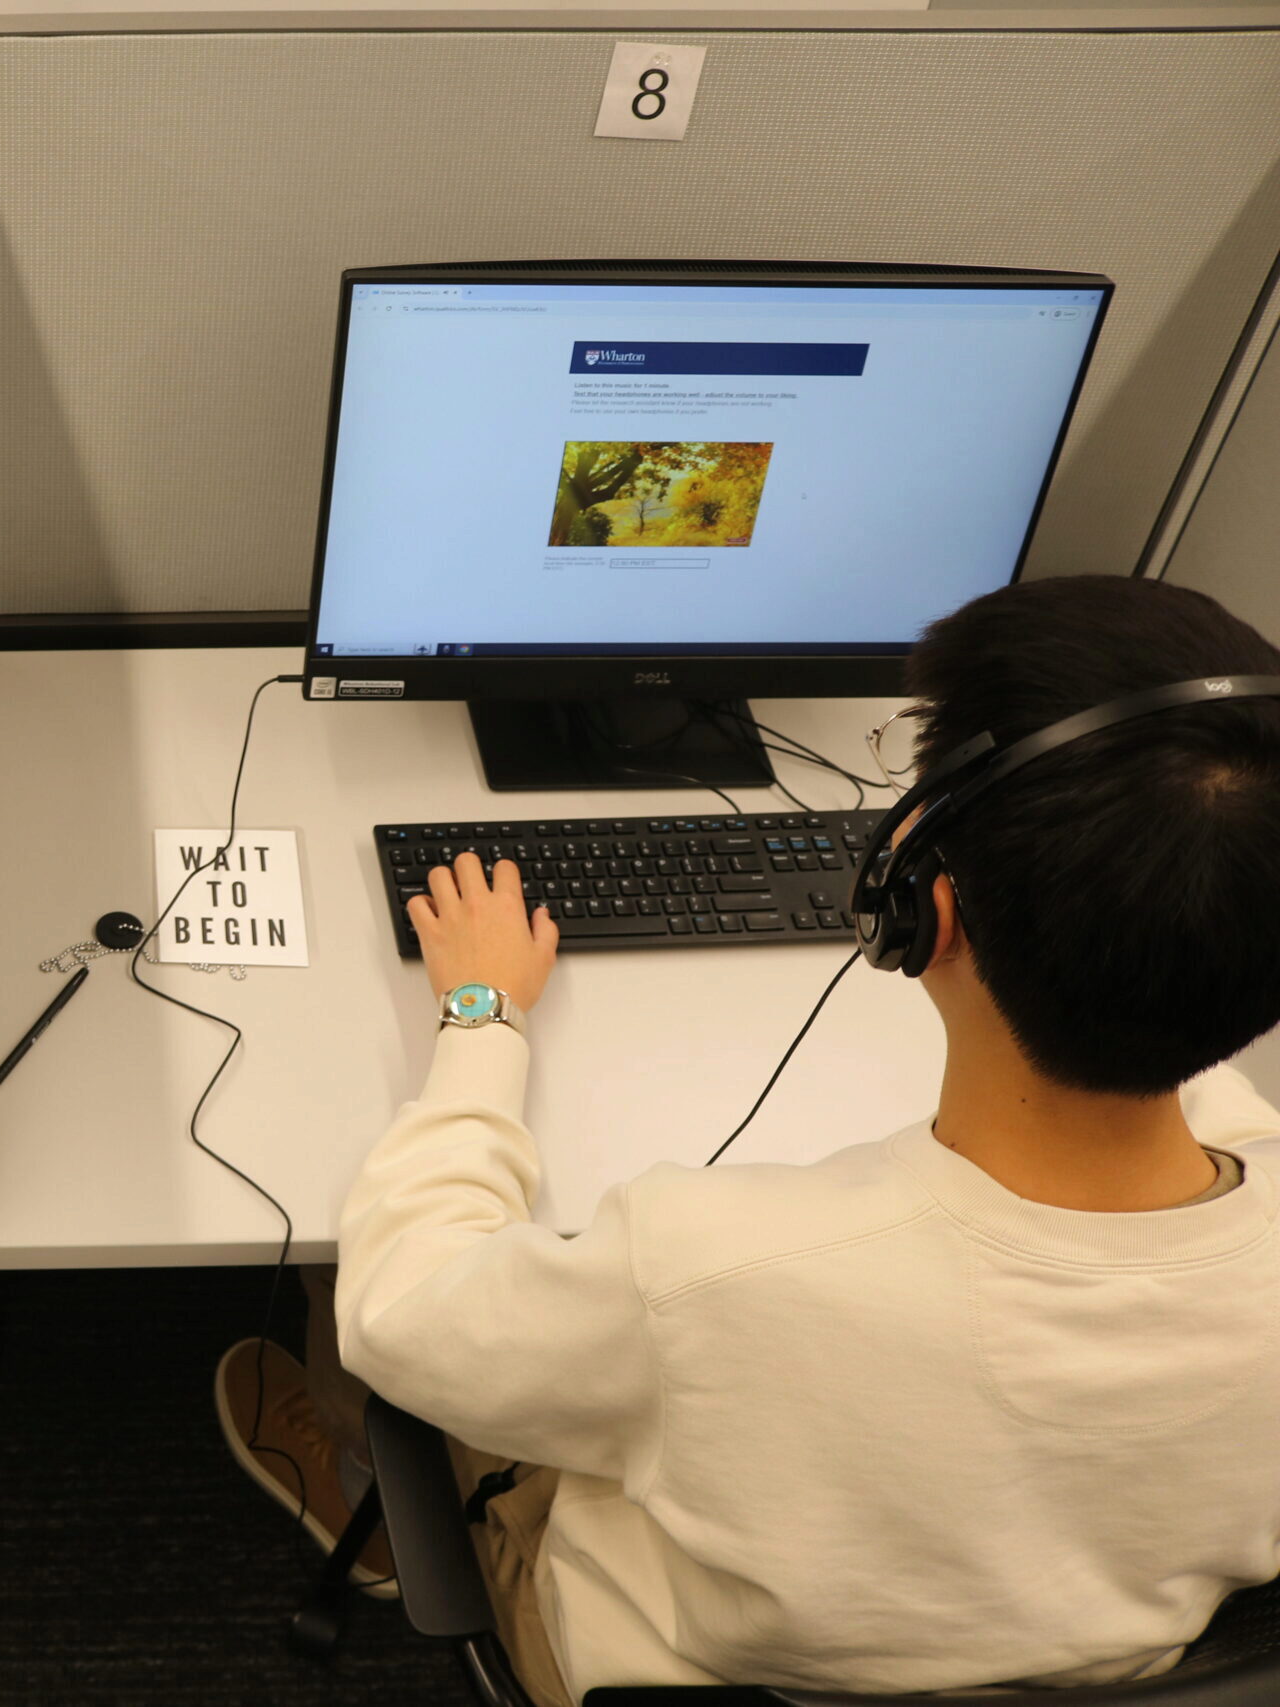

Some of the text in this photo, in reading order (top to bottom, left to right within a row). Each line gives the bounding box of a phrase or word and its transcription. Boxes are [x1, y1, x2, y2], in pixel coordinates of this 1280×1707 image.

[632, 68, 669, 120] 8
[600, 350, 646, 361] Wharton
[180, 846, 269, 872] WAIT
[206, 881, 247, 908] TO
[175, 917, 286, 947] BEGIN
